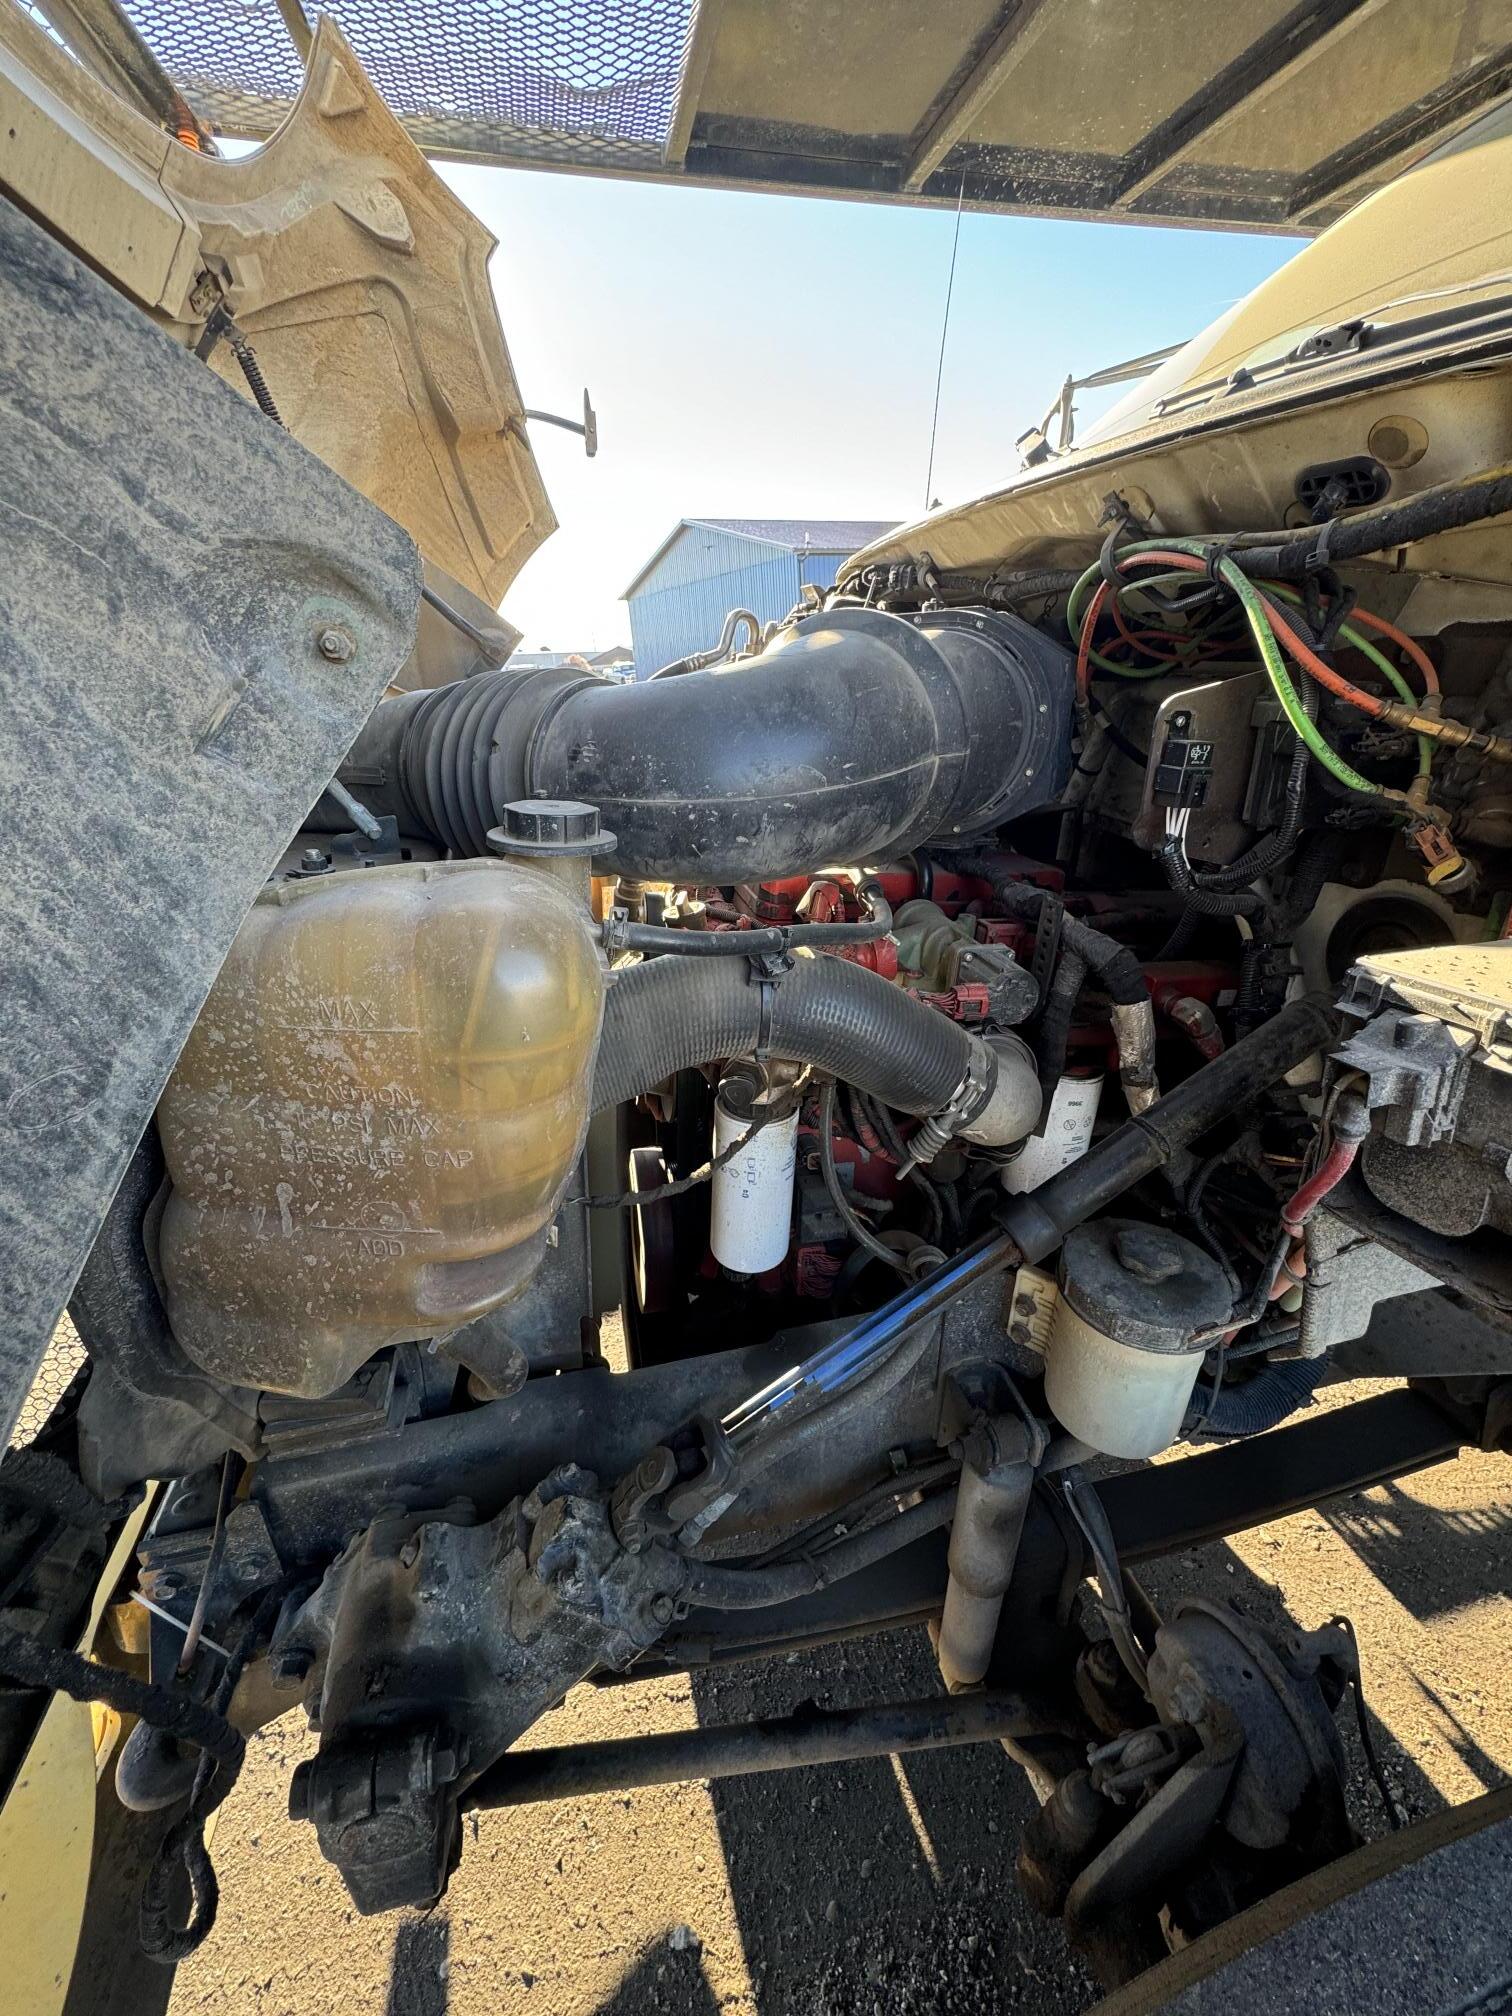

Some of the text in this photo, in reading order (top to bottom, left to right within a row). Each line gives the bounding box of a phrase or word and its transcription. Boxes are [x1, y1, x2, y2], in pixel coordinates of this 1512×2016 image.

[318, 1000, 379, 1026] MAX
[306, 1083, 415, 1105] CAUTION
[333, 1115, 373, 1135] PSI
[384, 1116, 441, 1136] MAX
[280, 1145, 474, 1169] PRESSURE CAP
[358, 1239, 405, 1258] ADD
